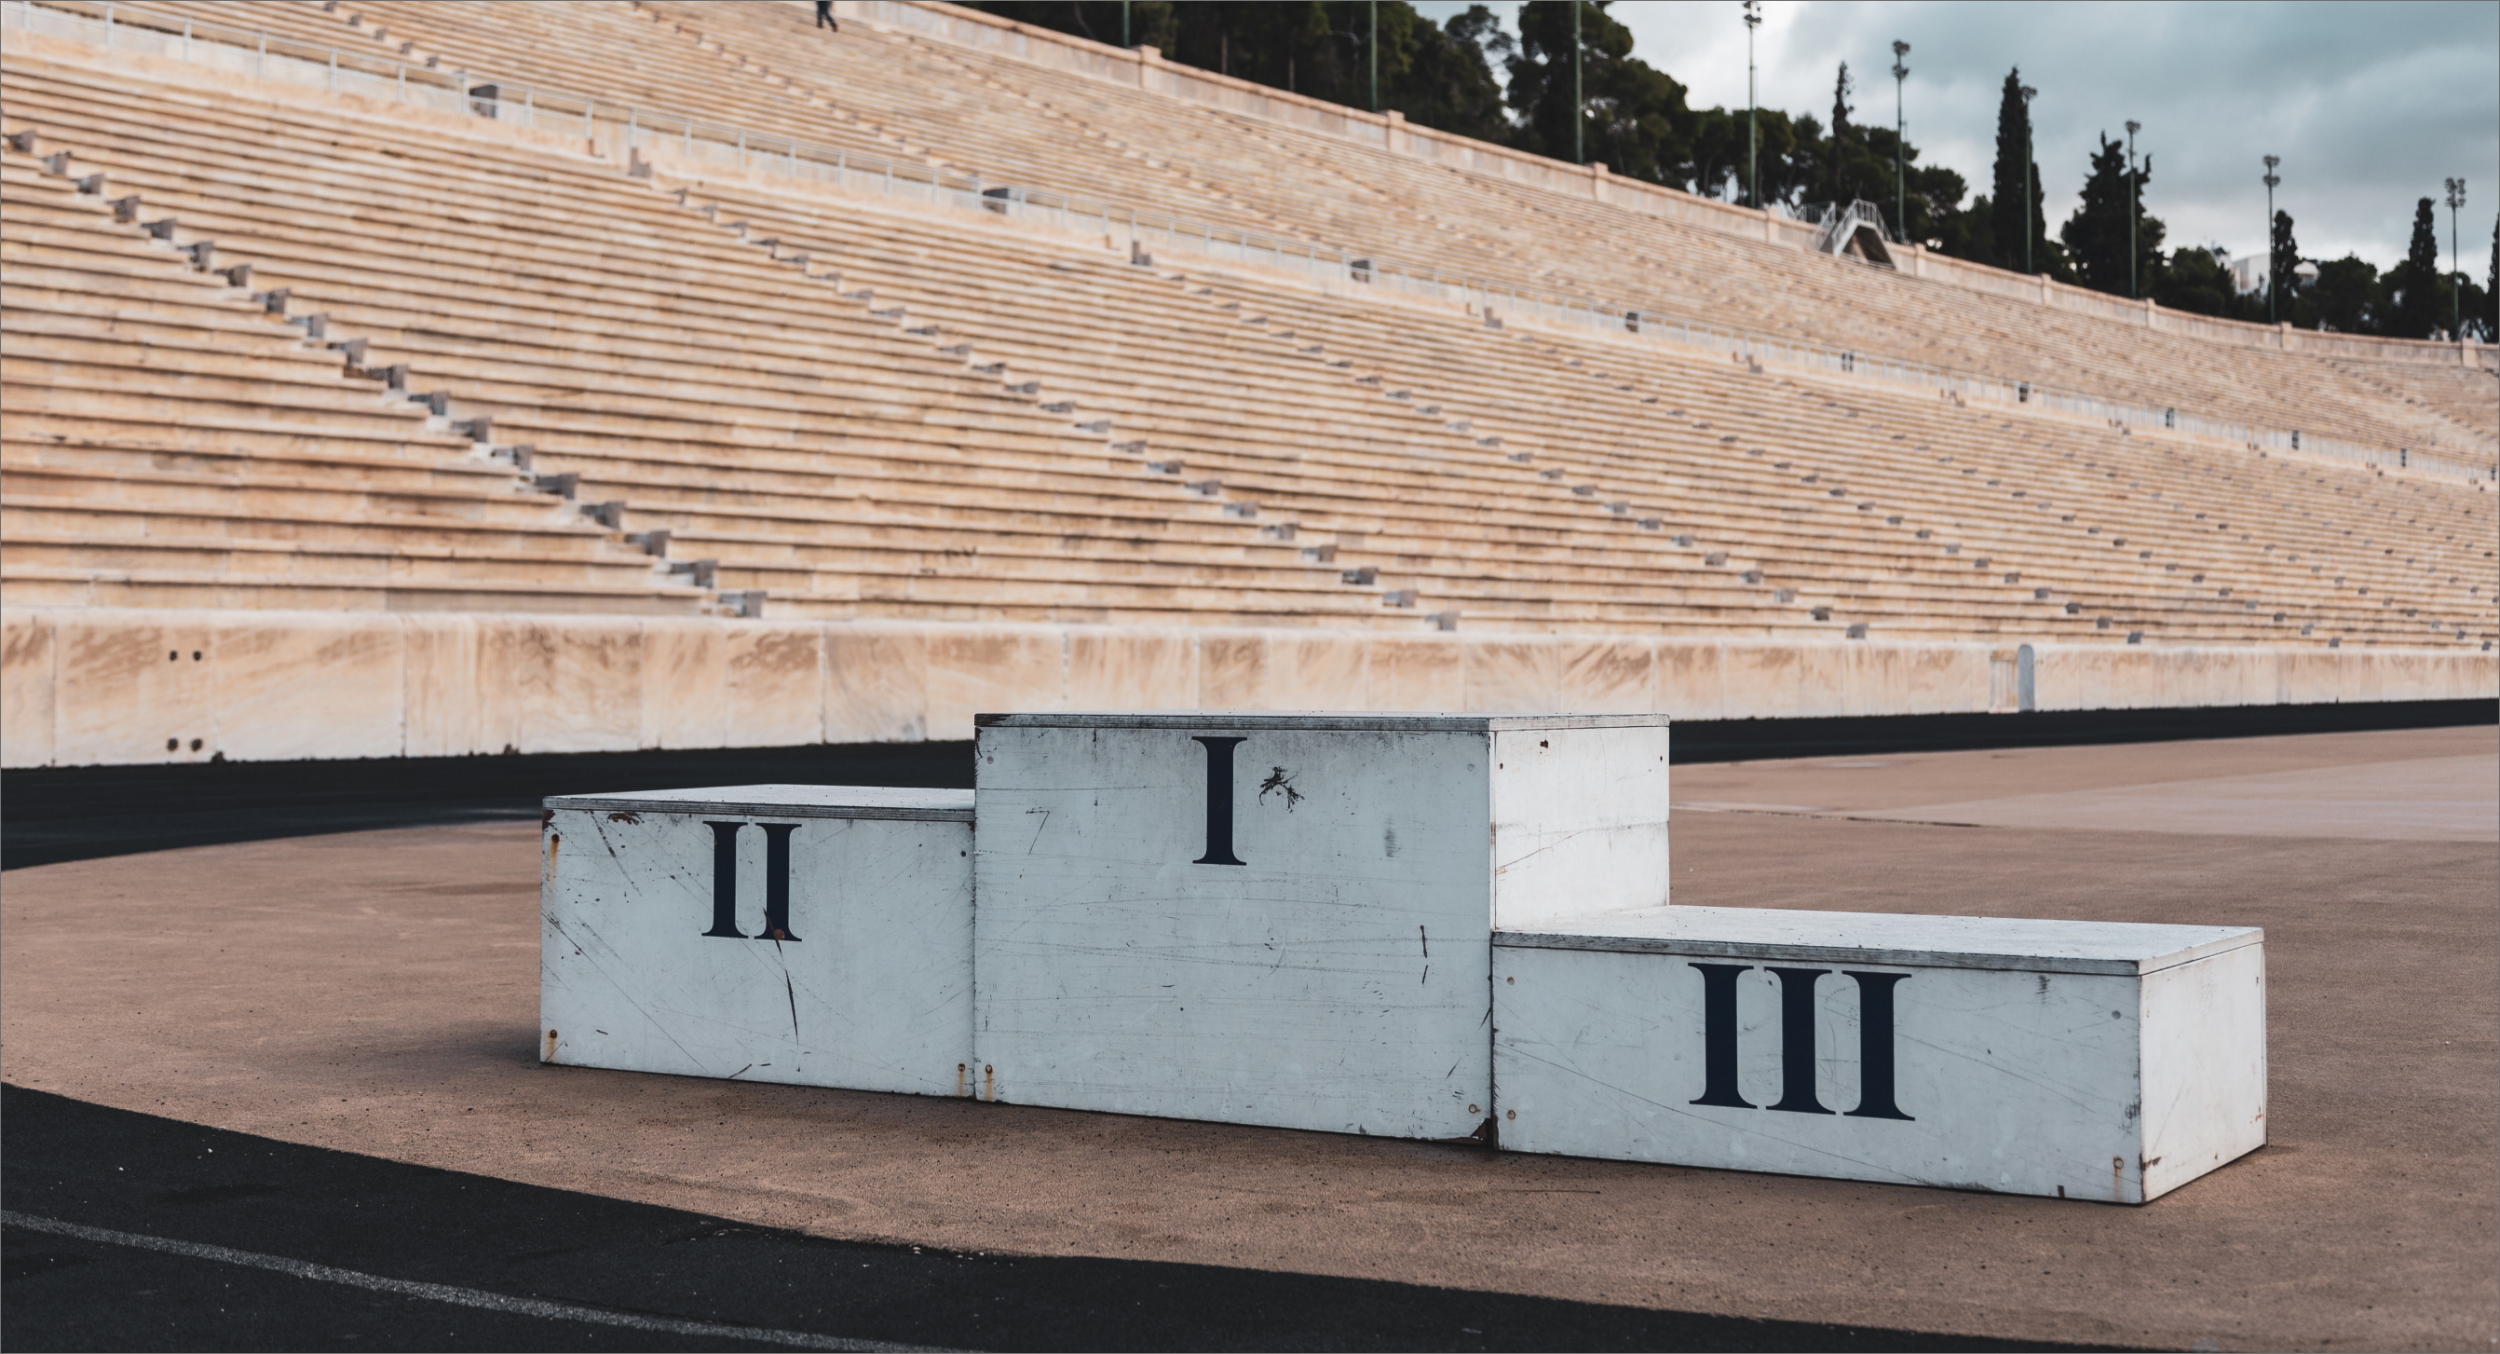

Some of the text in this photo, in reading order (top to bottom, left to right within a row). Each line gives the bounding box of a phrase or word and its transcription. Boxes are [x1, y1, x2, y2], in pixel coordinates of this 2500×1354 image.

[1191, 736, 1247, 866] I
[702, 821, 802, 942] II
[1688, 963, 1915, 1121] III
